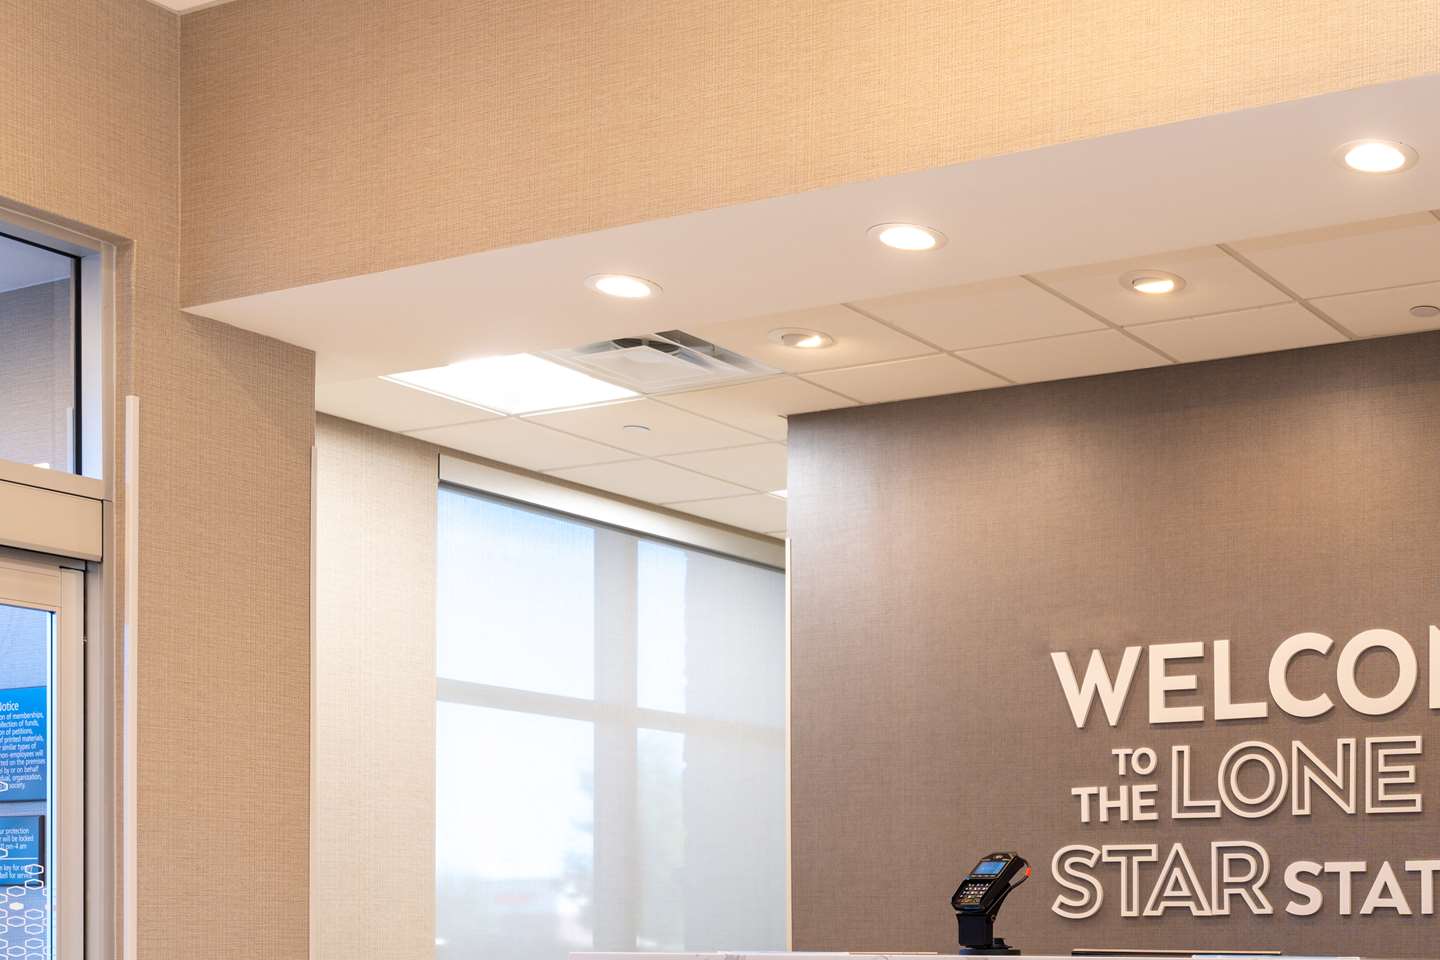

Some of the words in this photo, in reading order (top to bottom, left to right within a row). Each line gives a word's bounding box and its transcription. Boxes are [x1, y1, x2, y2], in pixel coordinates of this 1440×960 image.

[1111, 747, 1158, 776] TO
[1171, 735, 1423, 819] LONE
[1071, 784, 1159, 823] THE
[1051, 840, 1274, 920] STAR
